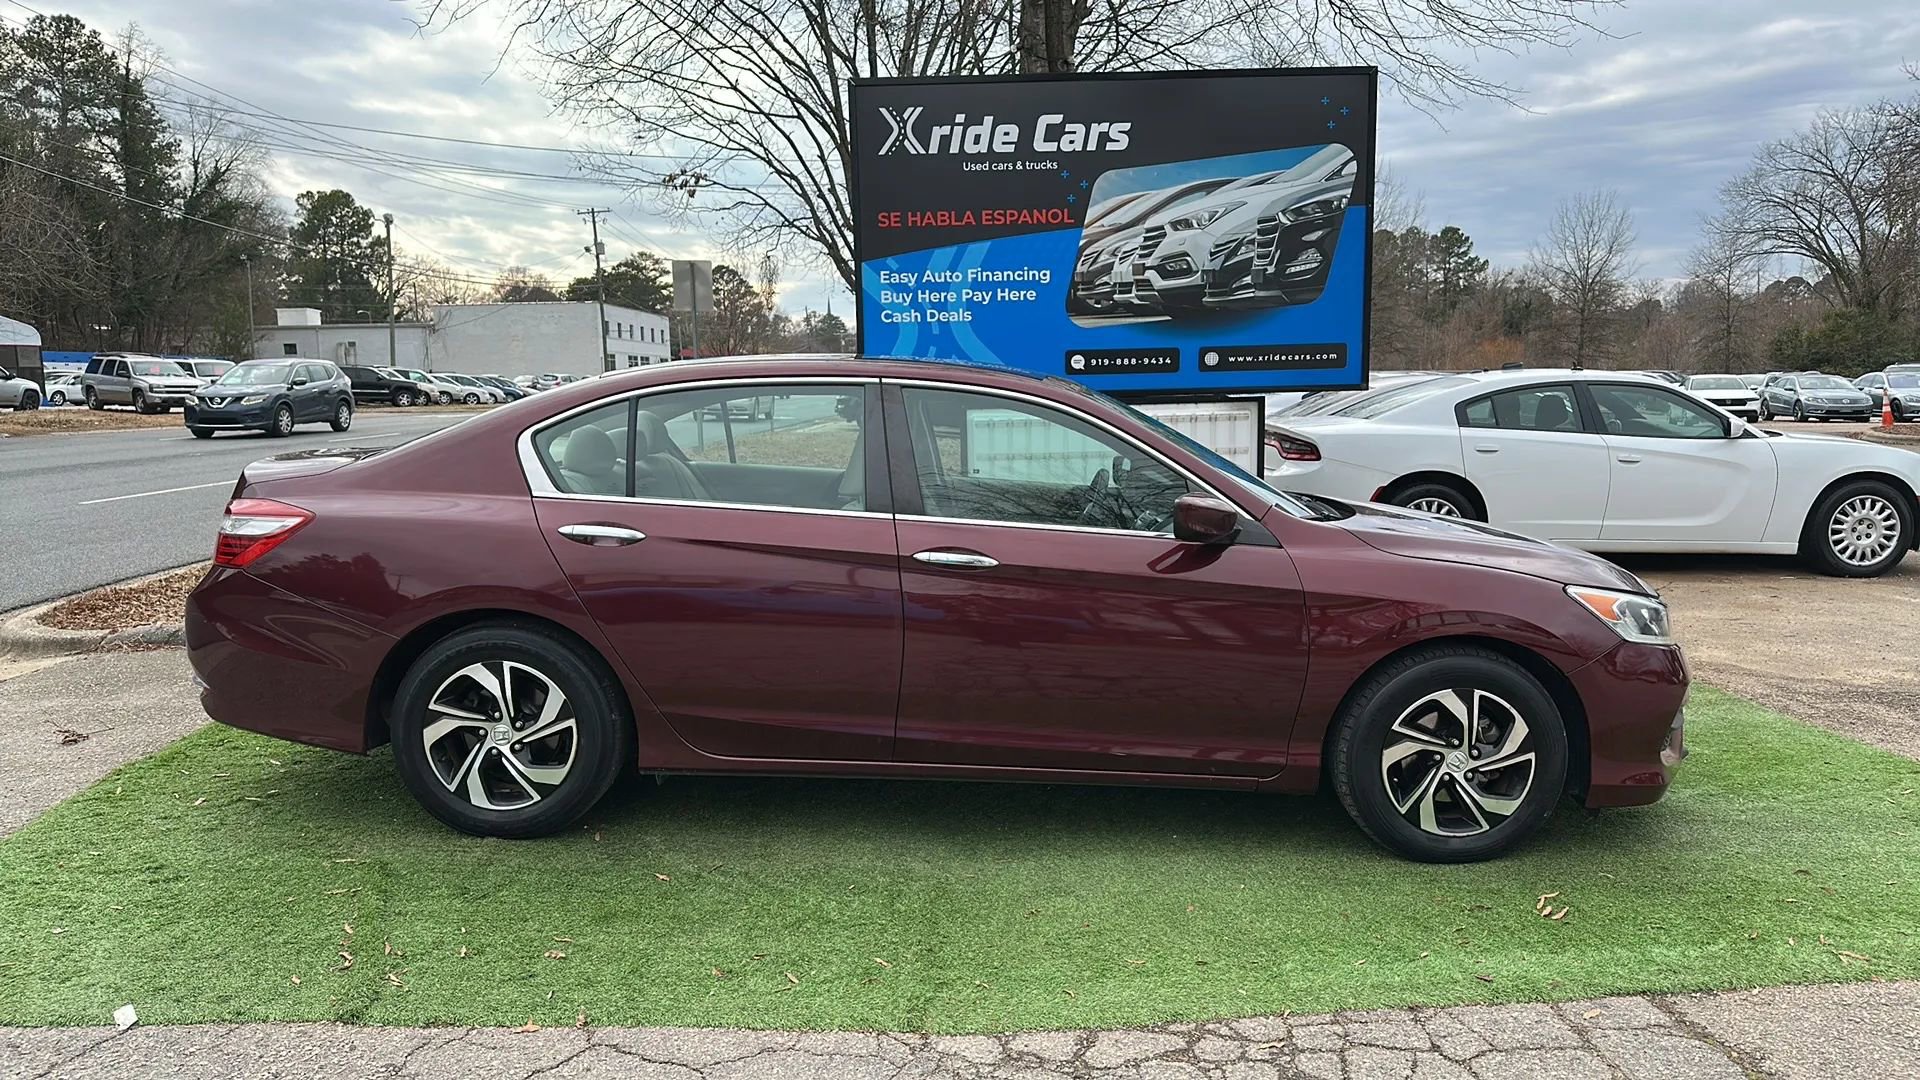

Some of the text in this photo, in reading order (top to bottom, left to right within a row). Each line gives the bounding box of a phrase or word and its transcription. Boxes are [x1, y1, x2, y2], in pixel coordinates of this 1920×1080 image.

[1033, 113, 1132, 152] Cars
[963, 160, 1058, 171] Used cars & trucks
[878, 208, 1075, 227] SE HABLA ESPANOL
[880, 267, 1051, 286] Easy Auto Financing
[880, 288, 1037, 306] Buy Here Pay Here
[881, 308, 973, 323] Cash Deals
[1090, 356, 1172, 366] 919-888-9434
[1228, 352, 1338, 363] www.xridecars.com
